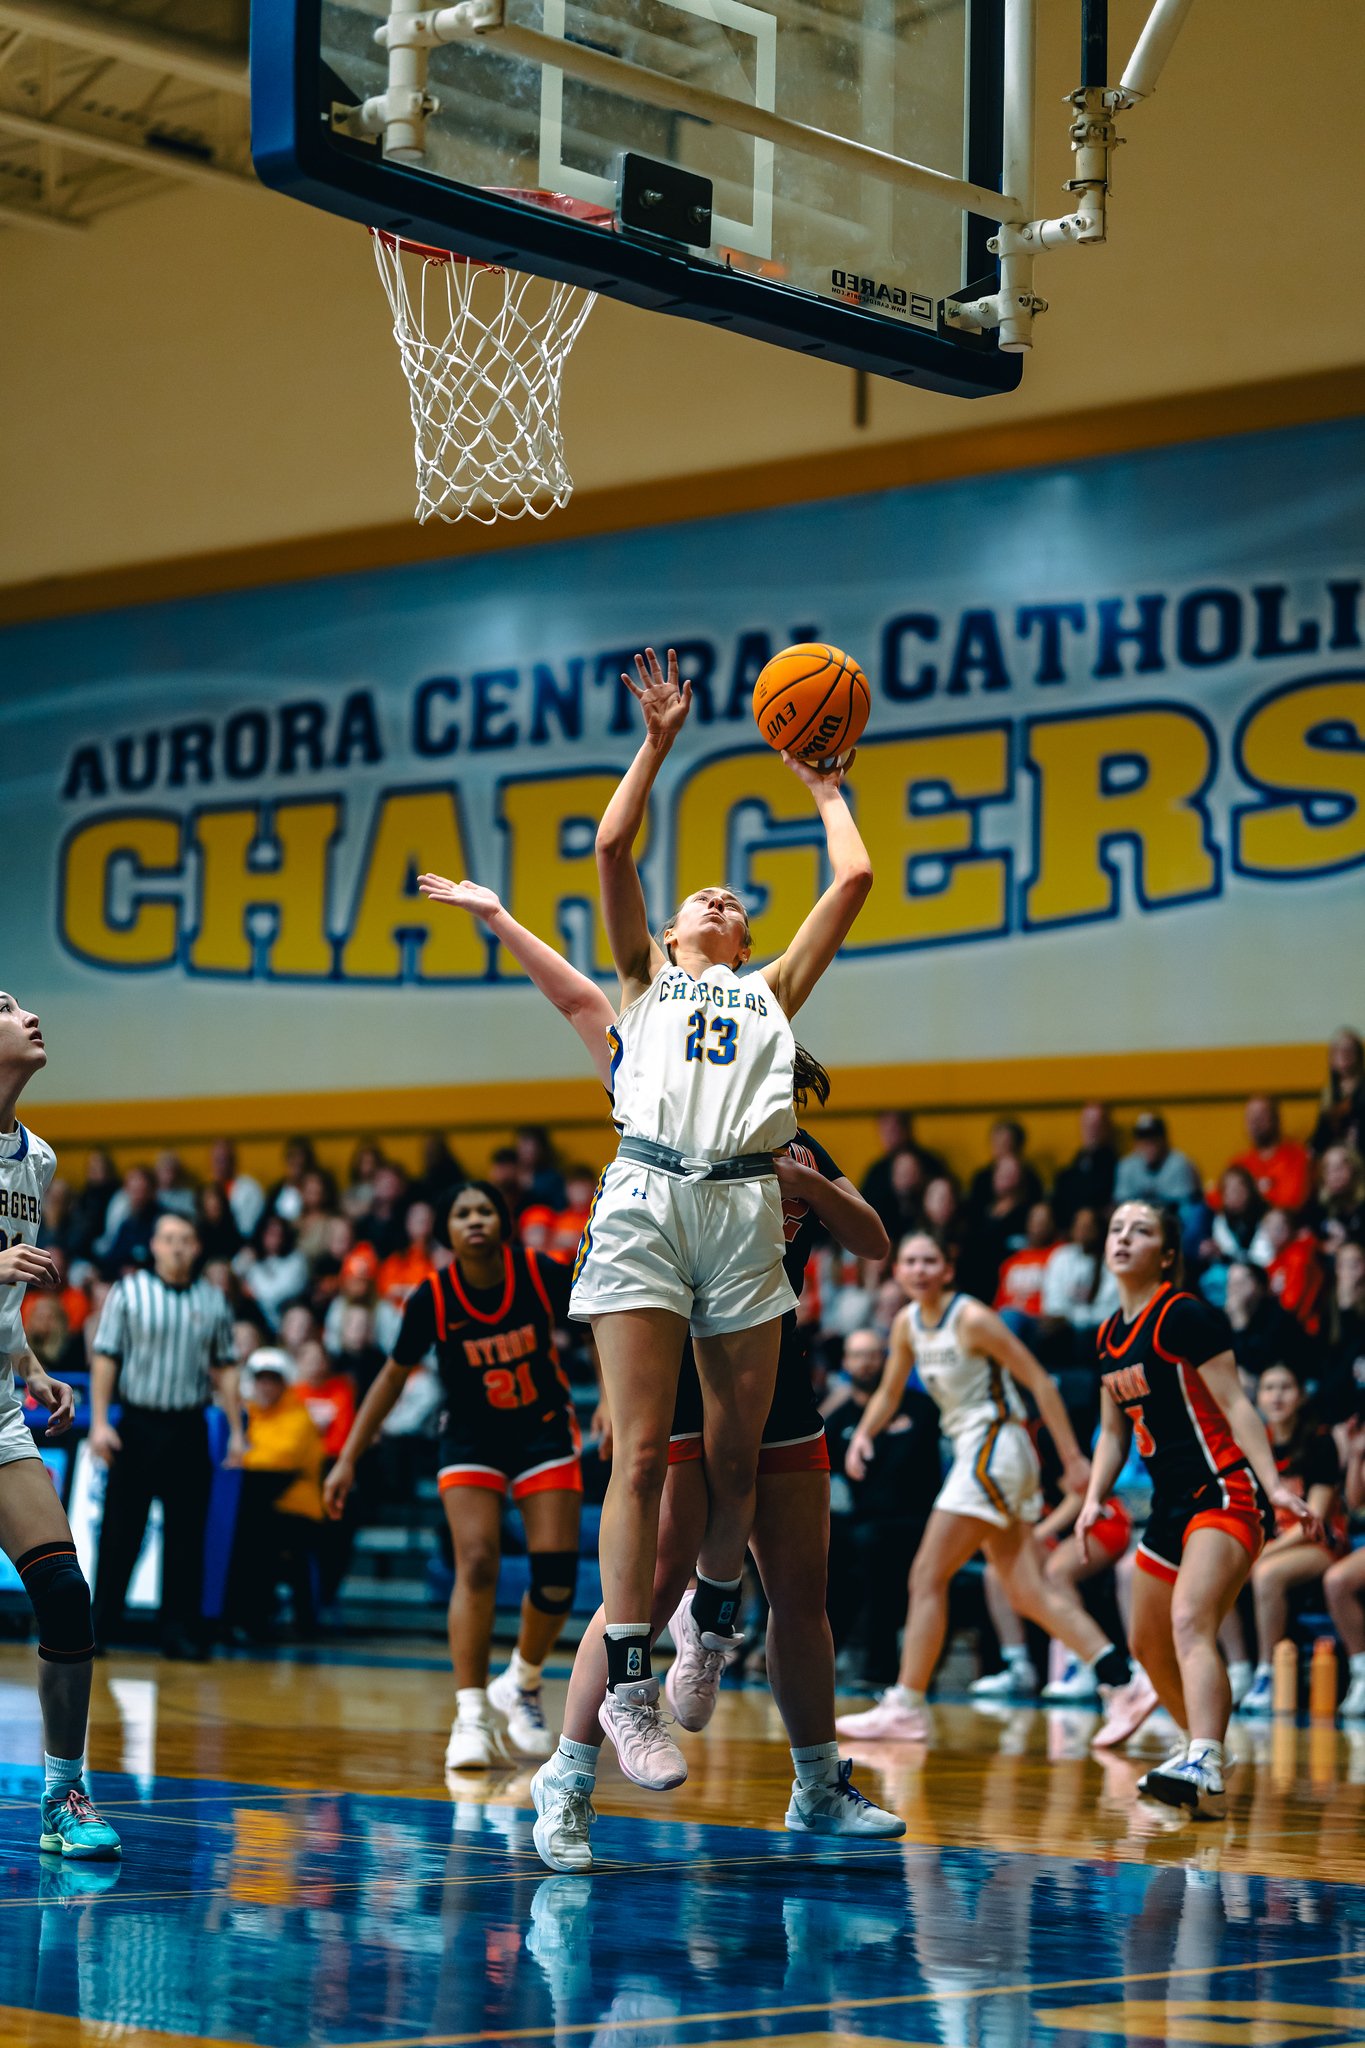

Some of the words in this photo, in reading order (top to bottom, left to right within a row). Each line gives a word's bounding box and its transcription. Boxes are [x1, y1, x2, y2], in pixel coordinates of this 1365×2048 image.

[61, 689, 383, 800] AURORA
[410, 625, 824, 759] CENTRA
[57, 668, 1365, 984] CHARGERS
[659, 980, 768, 1017] CHARGERS
[685, 1010, 740, 1066] 23
[483, 1361, 538, 1409] 21
